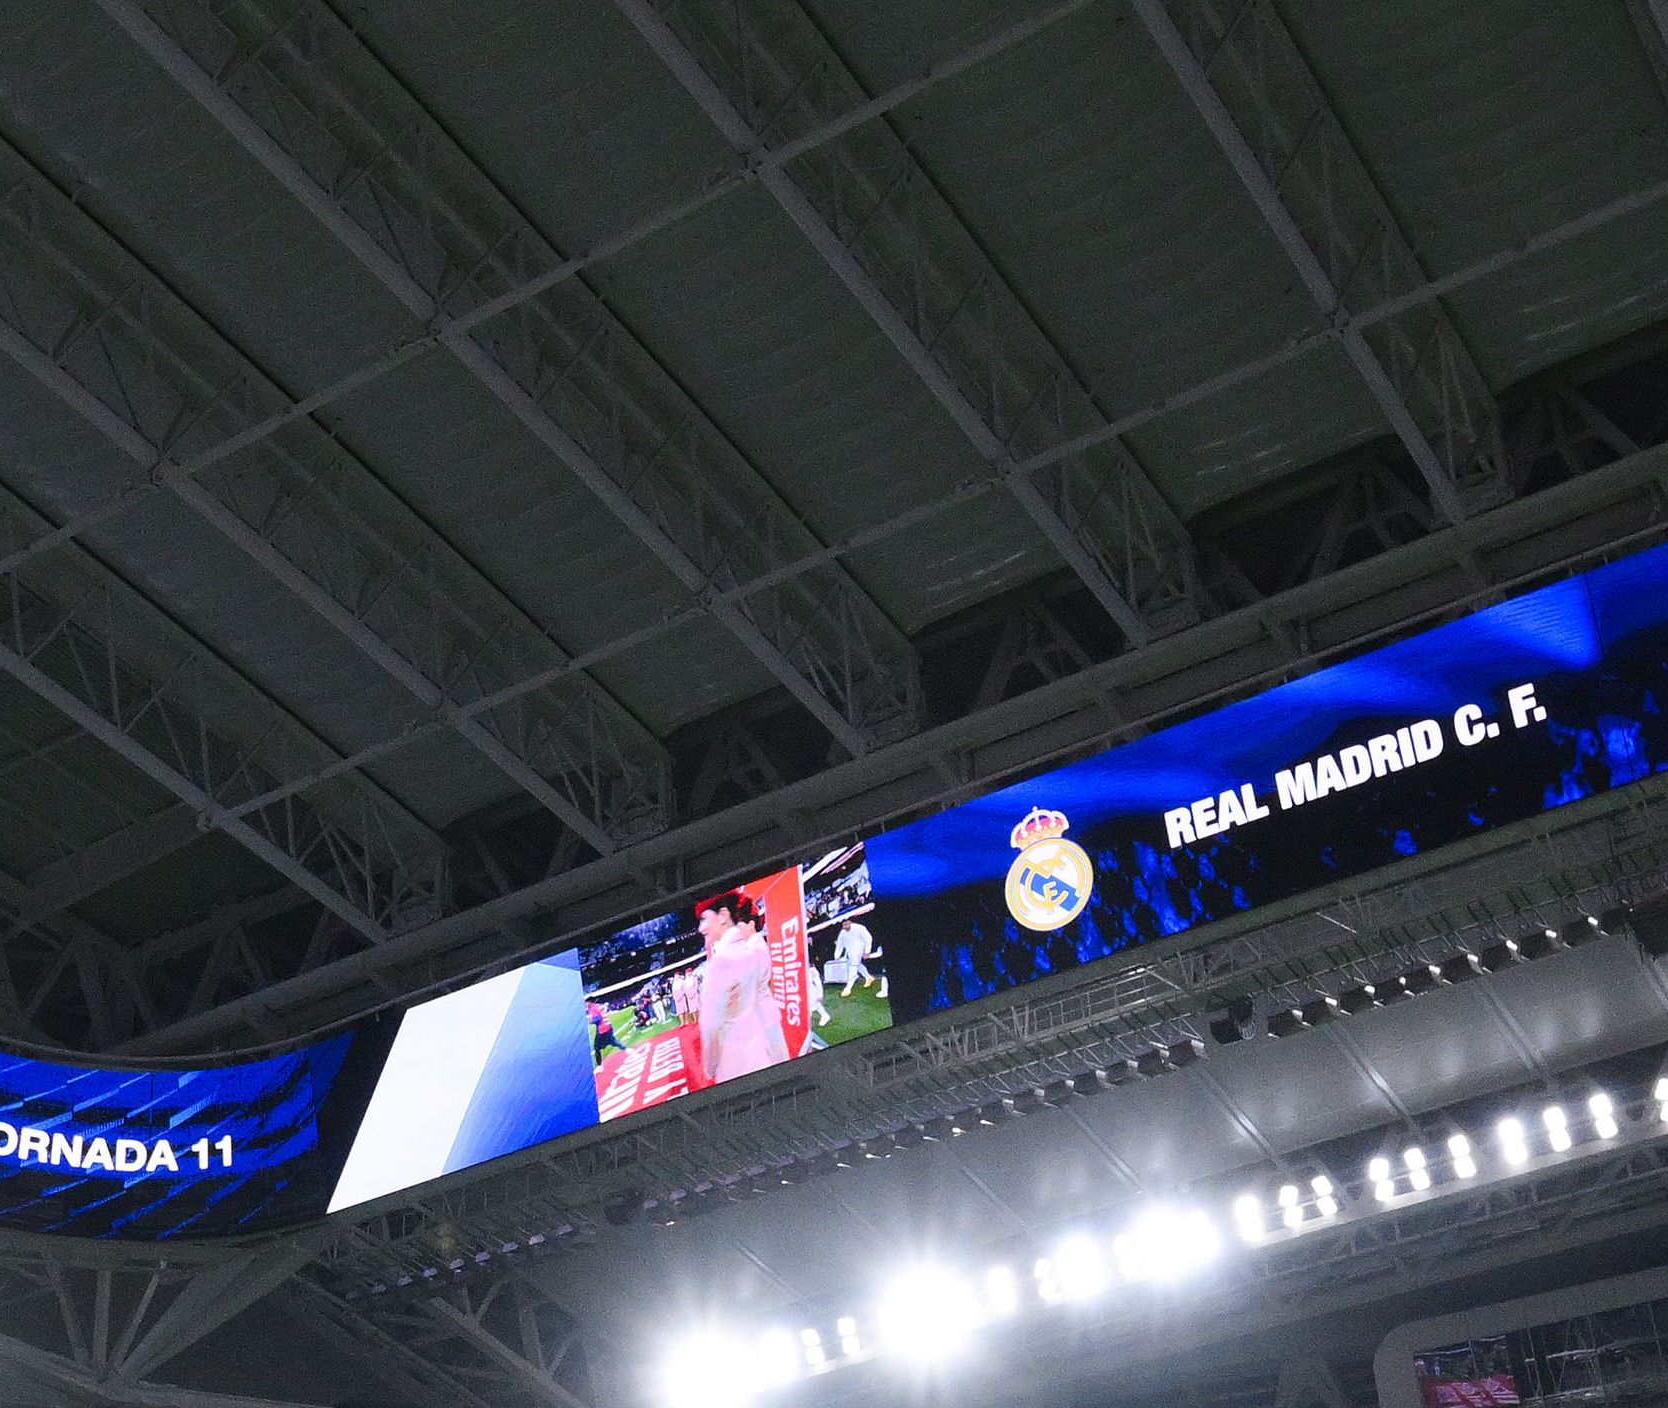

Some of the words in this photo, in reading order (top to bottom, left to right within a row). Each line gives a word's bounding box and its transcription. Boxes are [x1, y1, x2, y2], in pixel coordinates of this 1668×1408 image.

[1164, 783, 1270, 849] REAL
[1275, 719, 1444, 810] MADRID
[1454, 704, 1500, 746] C.
[1508, 683, 1547, 729] F.
[780, 915, 803, 1028] Emirates
[191, 1135, 232, 1170] 11
